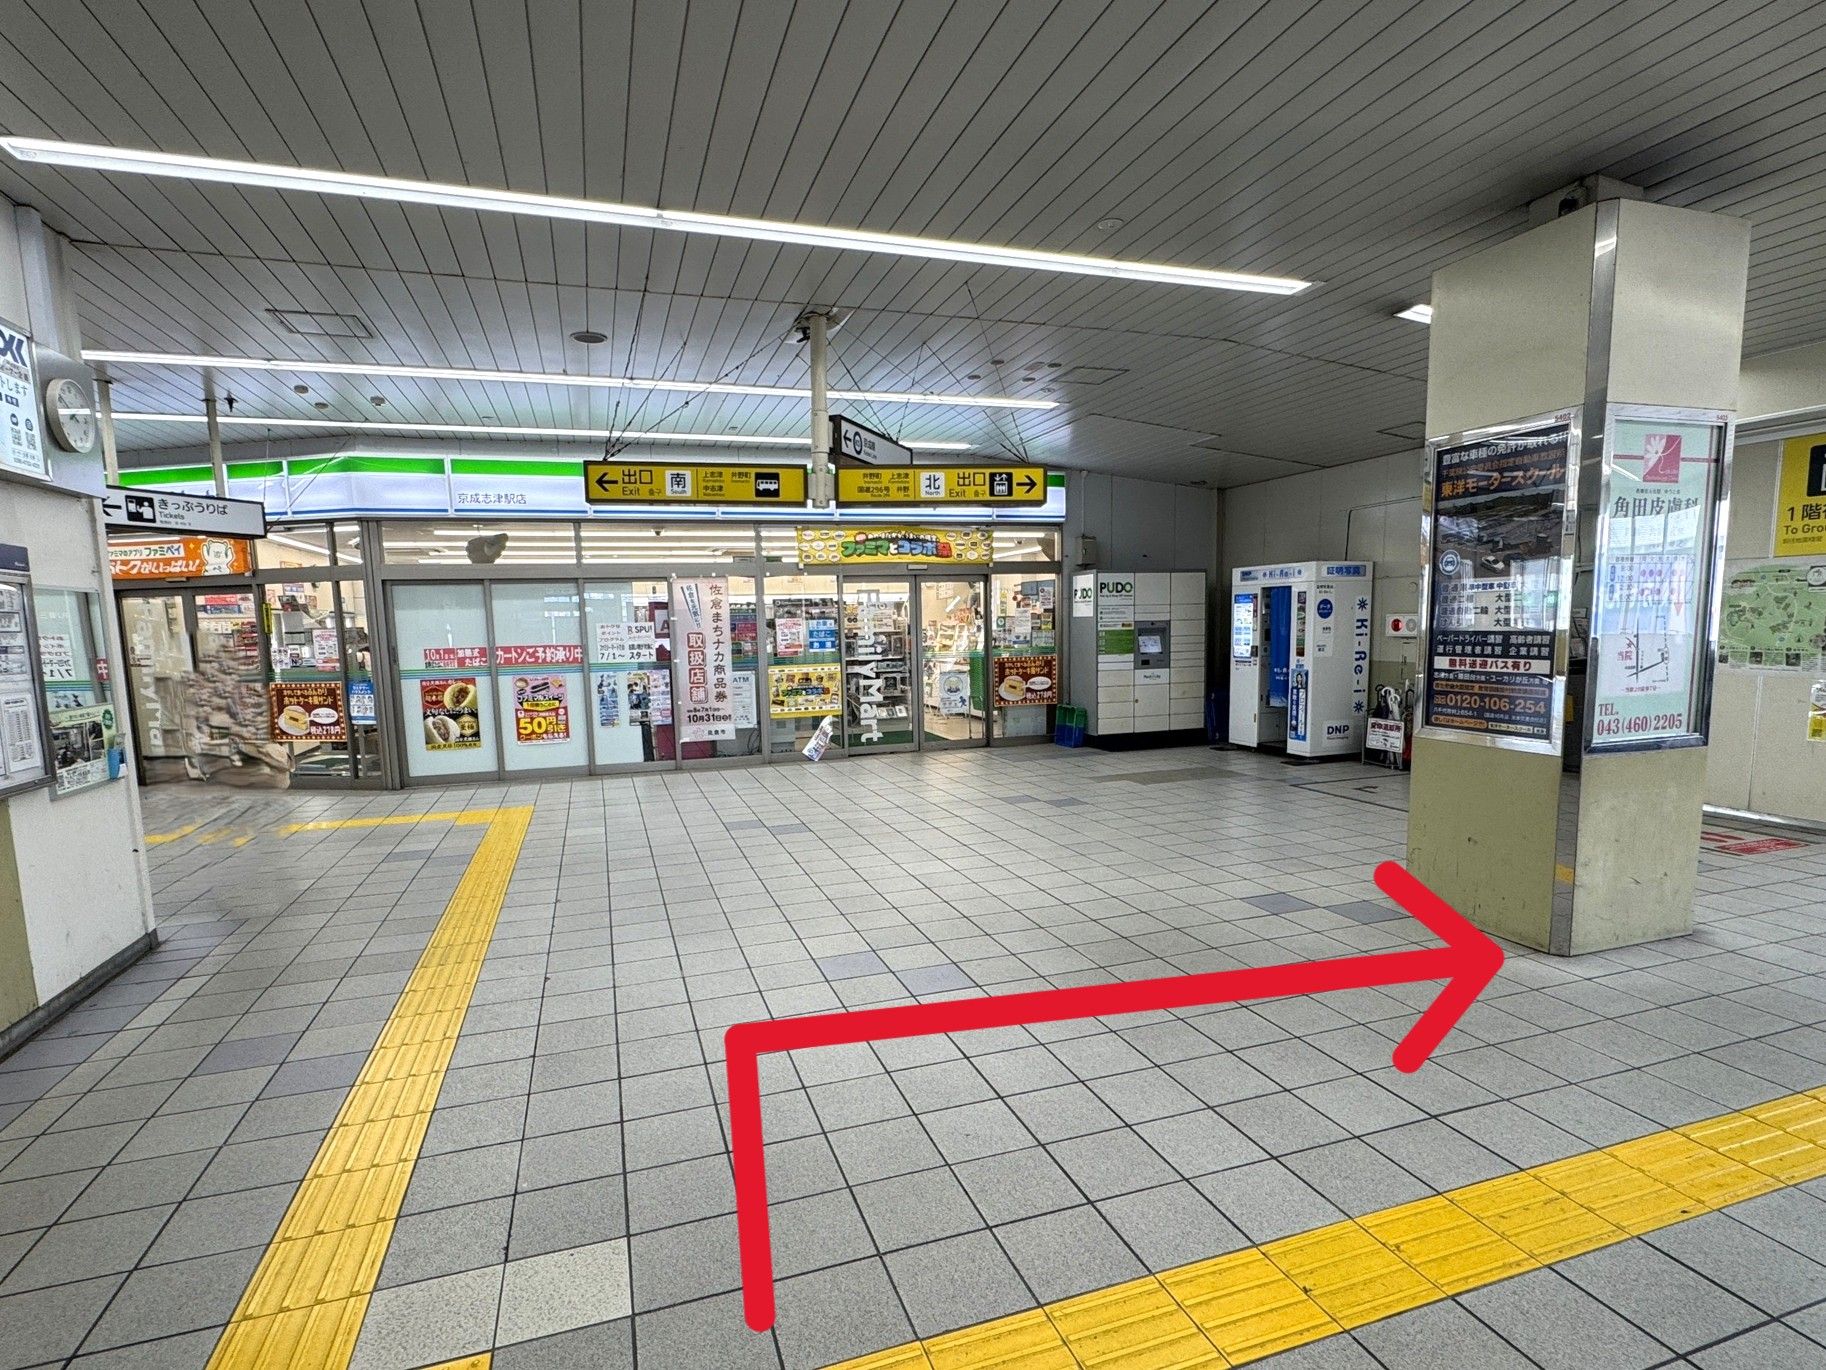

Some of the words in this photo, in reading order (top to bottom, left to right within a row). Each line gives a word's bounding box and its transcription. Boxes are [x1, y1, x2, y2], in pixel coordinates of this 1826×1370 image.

[622, 469, 653, 485] 出口
[670, 472, 686, 489] 南
[703, 471, 723, 479] 上志津
[925, 474, 940, 490] 北
[957, 472, 986, 487] 出口
[1441, 463, 1565, 497] 東洋モータースクール
[622, 486, 640, 496] Exit
[857, 486, 890, 494] 国道296号
[897, 486, 910, 494] 井野
[949, 488, 967, 498] Exit
[457, 492, 527, 505] 京成志津駅店
[158, 498, 228, 515] きっぷうりば
[159, 511, 185, 520] Tickets
[1783, 525, 1799, 536] To
[143, 545, 182, 556] ファミペイ
[1100, 582, 1133, 594] PUDO
[709, 584, 728, 703] 佐倉まちナカ商品券
[1436, 634, 1503, 644] ペーパードライバー講習
[464, 658, 488, 667] たばこ
[496, 648, 583, 664] カートンご予約承り中
[629, 651, 654, 661] スタート
[1354, 618, 1369, 694] Ki-Re-i
[687, 633, 707, 703] 取扱店舗
[1448, 658, 1533, 672] 無料送迎バス有り
[1446, 693, 1547, 714] 0120-106-254
[1598, 702, 1619, 717] TEL.
[519, 717, 546, 735] 50
[1327, 725, 1350, 735] DNP
[1597, 713, 1683, 736] 043(460)2205
